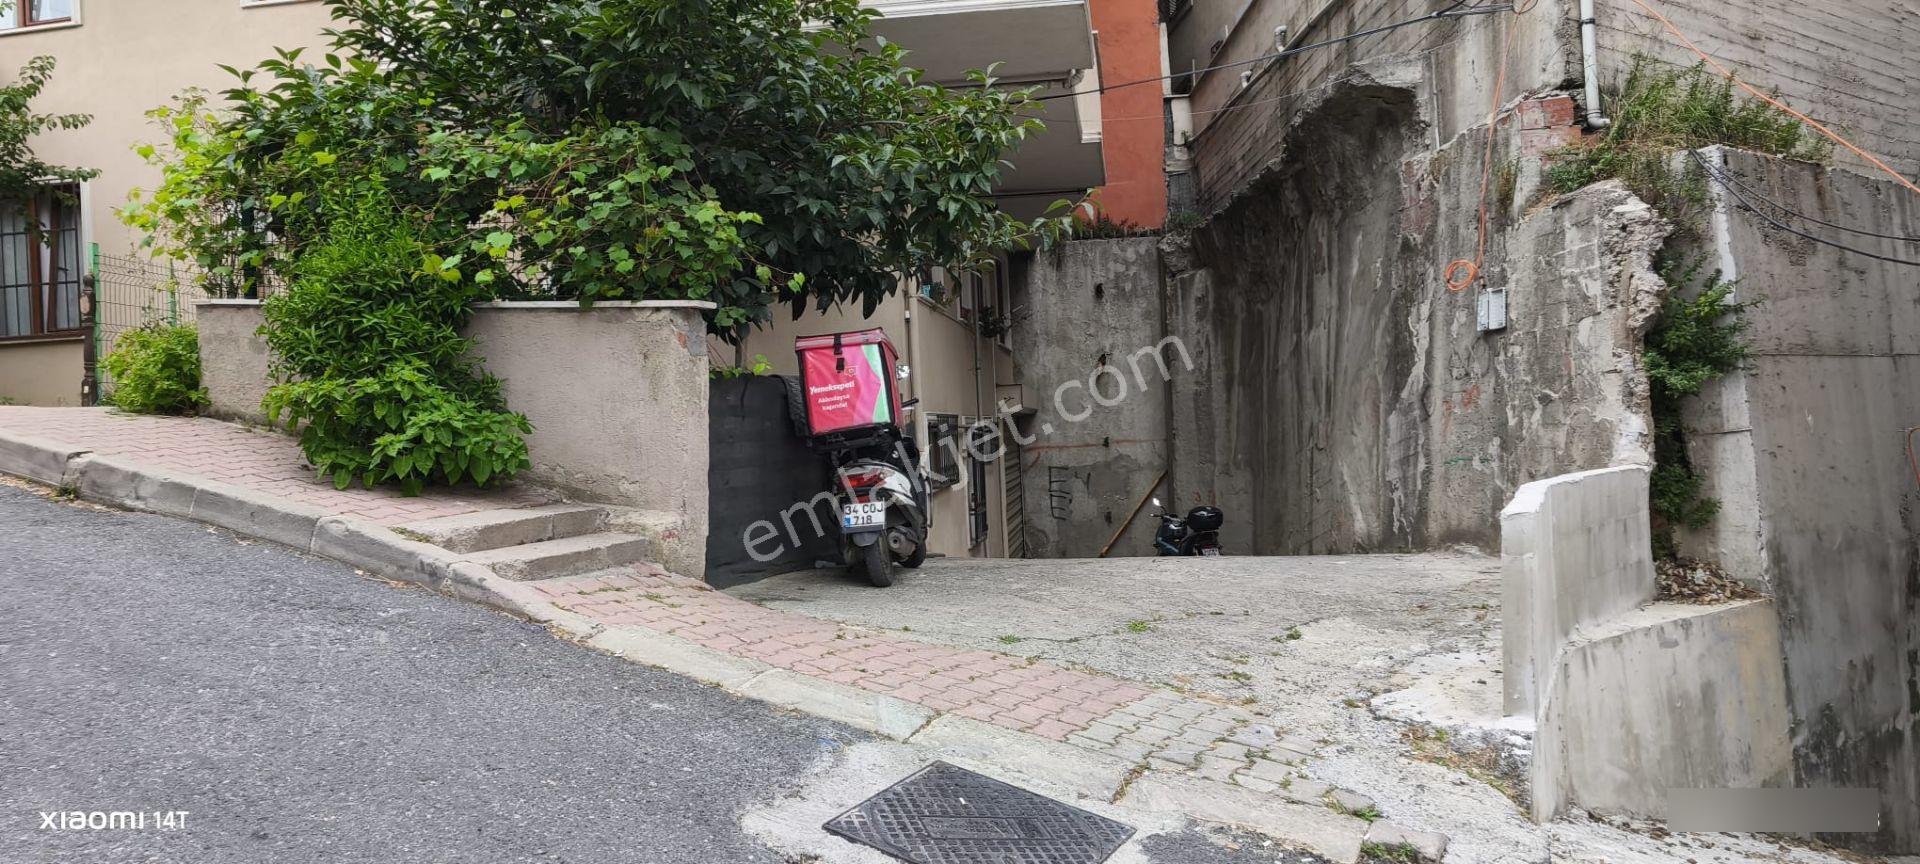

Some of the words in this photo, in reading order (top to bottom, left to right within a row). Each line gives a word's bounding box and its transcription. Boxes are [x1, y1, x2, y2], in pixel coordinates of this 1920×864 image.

[809, 380, 855, 395] Yemeksepeti
[845, 504, 859, 515] 34
[862, 502, 884, 514] COJ
[853, 514, 873, 525] 718
